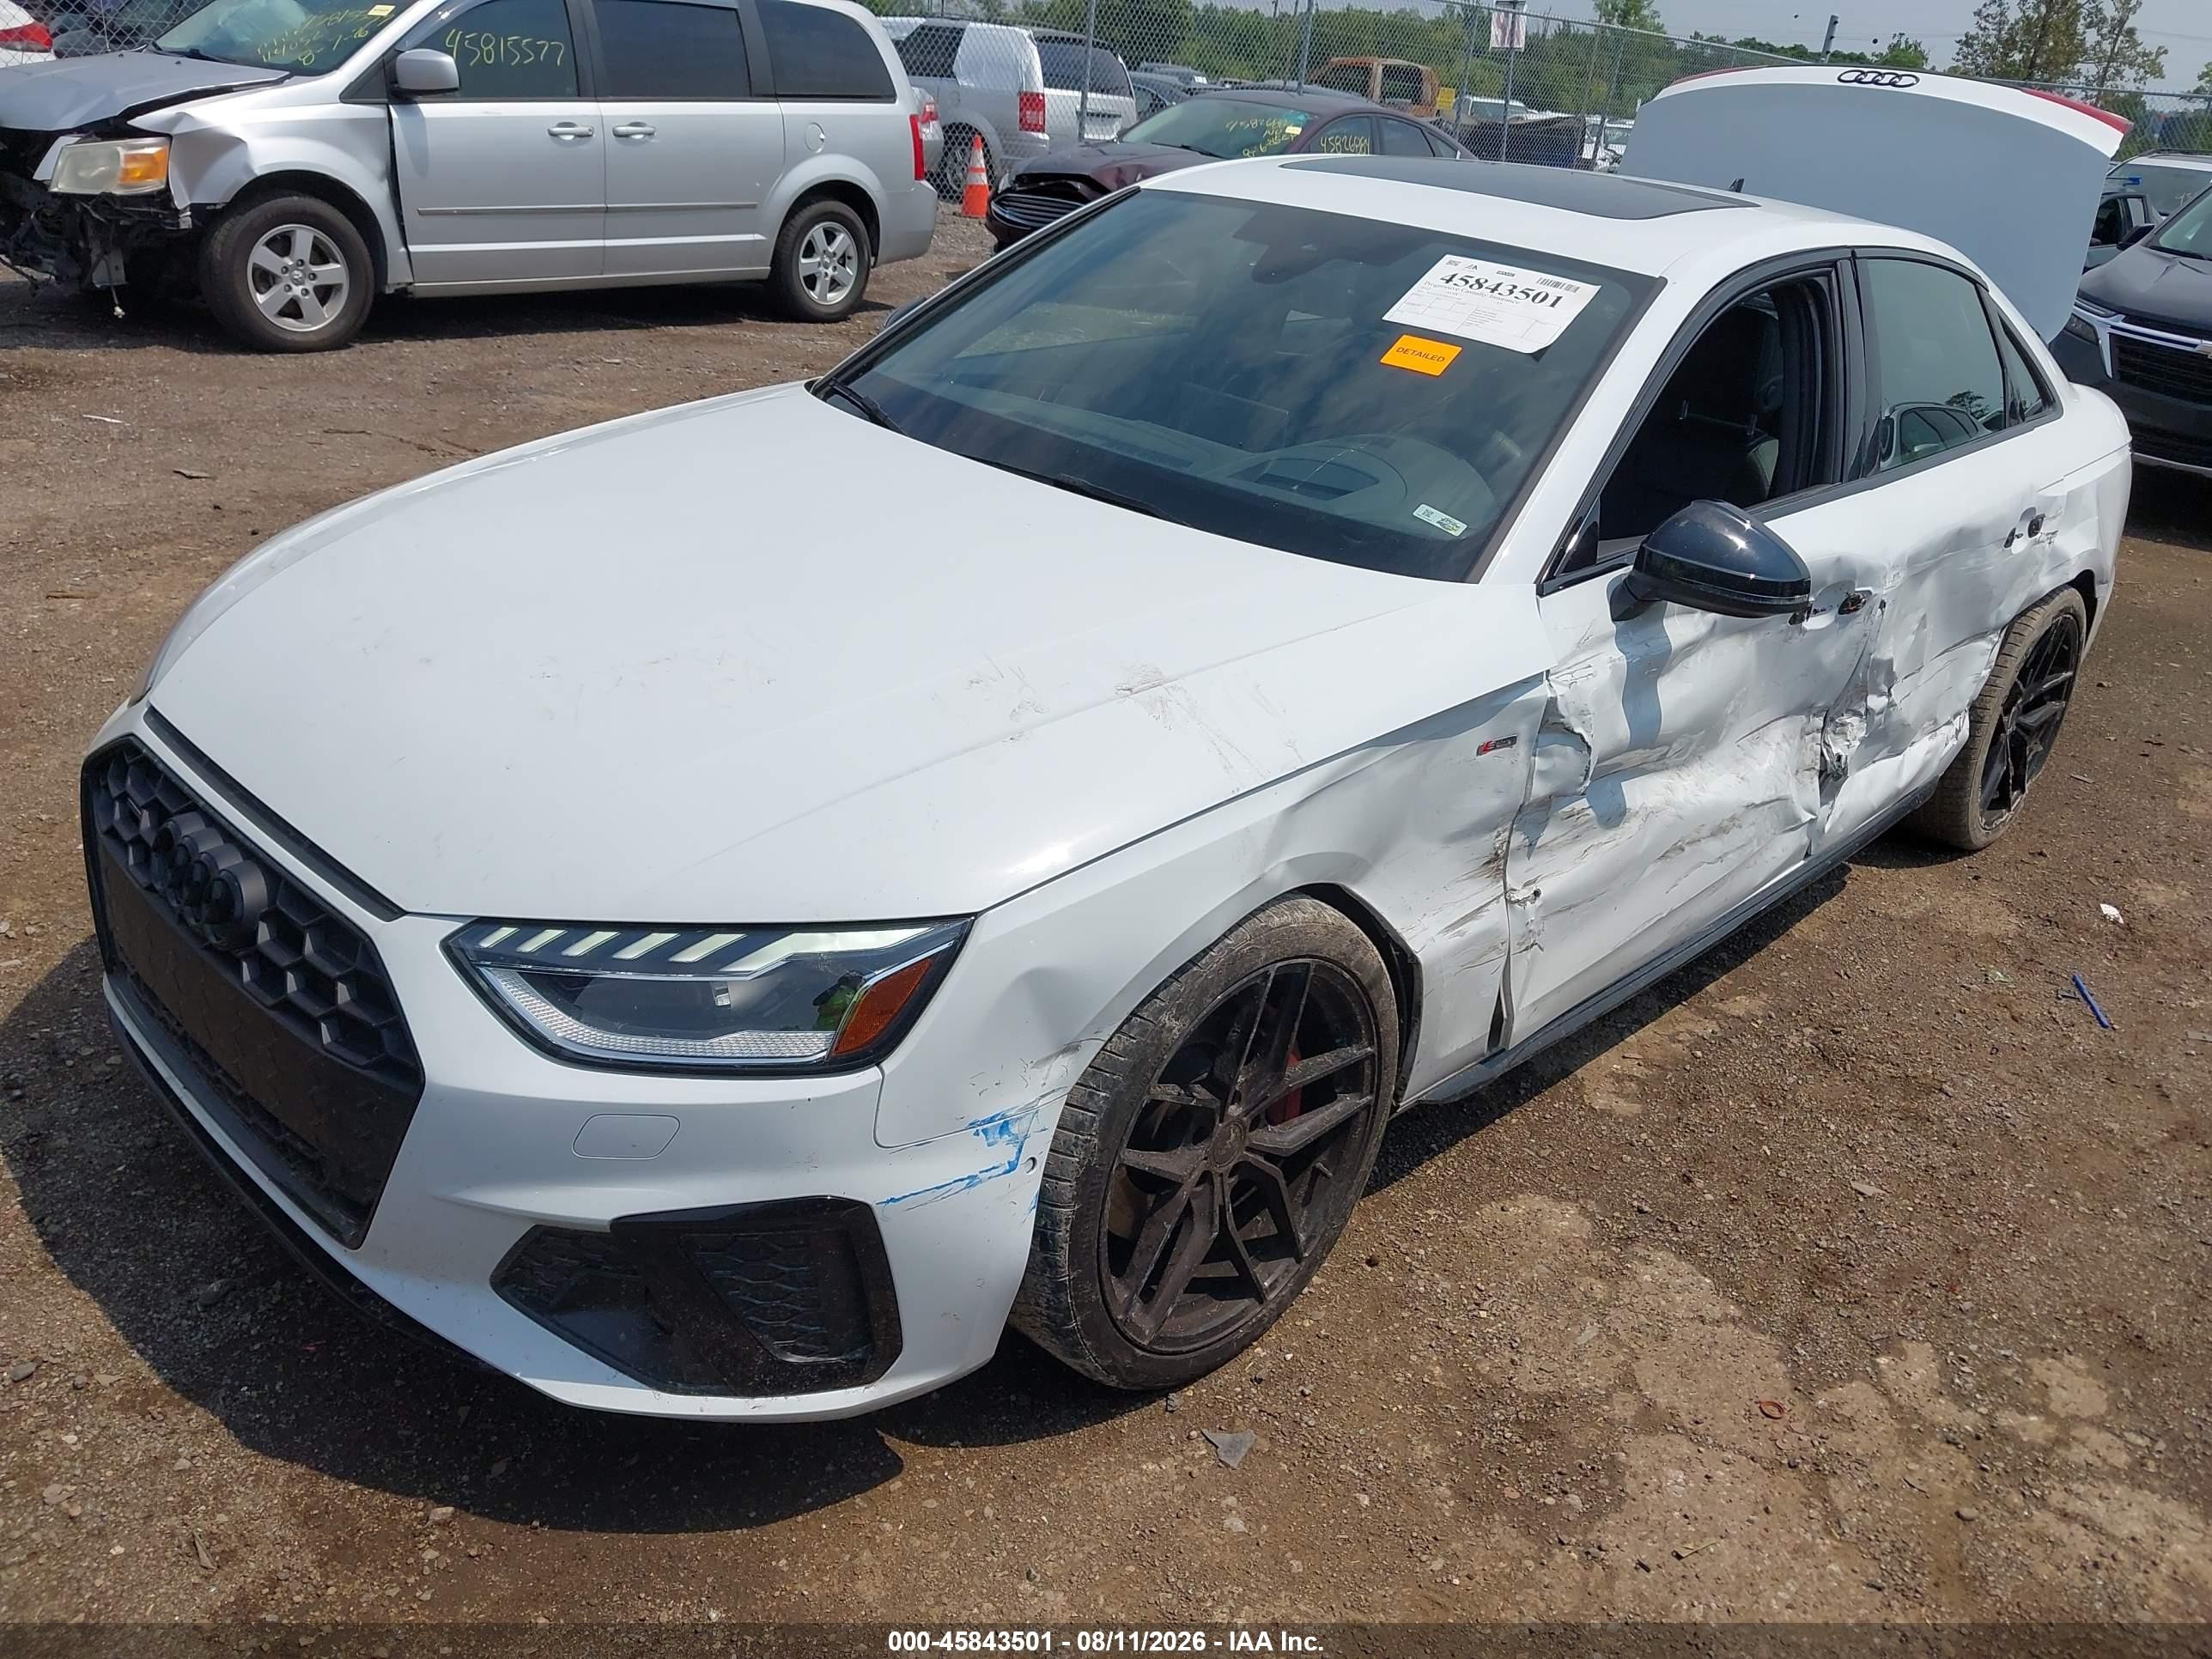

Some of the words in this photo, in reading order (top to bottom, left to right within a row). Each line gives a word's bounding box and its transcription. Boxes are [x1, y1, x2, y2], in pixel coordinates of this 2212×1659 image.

[446, 28, 564, 66] 45815577
[1440, 273, 1564, 308] 45843501
[1396, 346, 1445, 362] DETAILED
